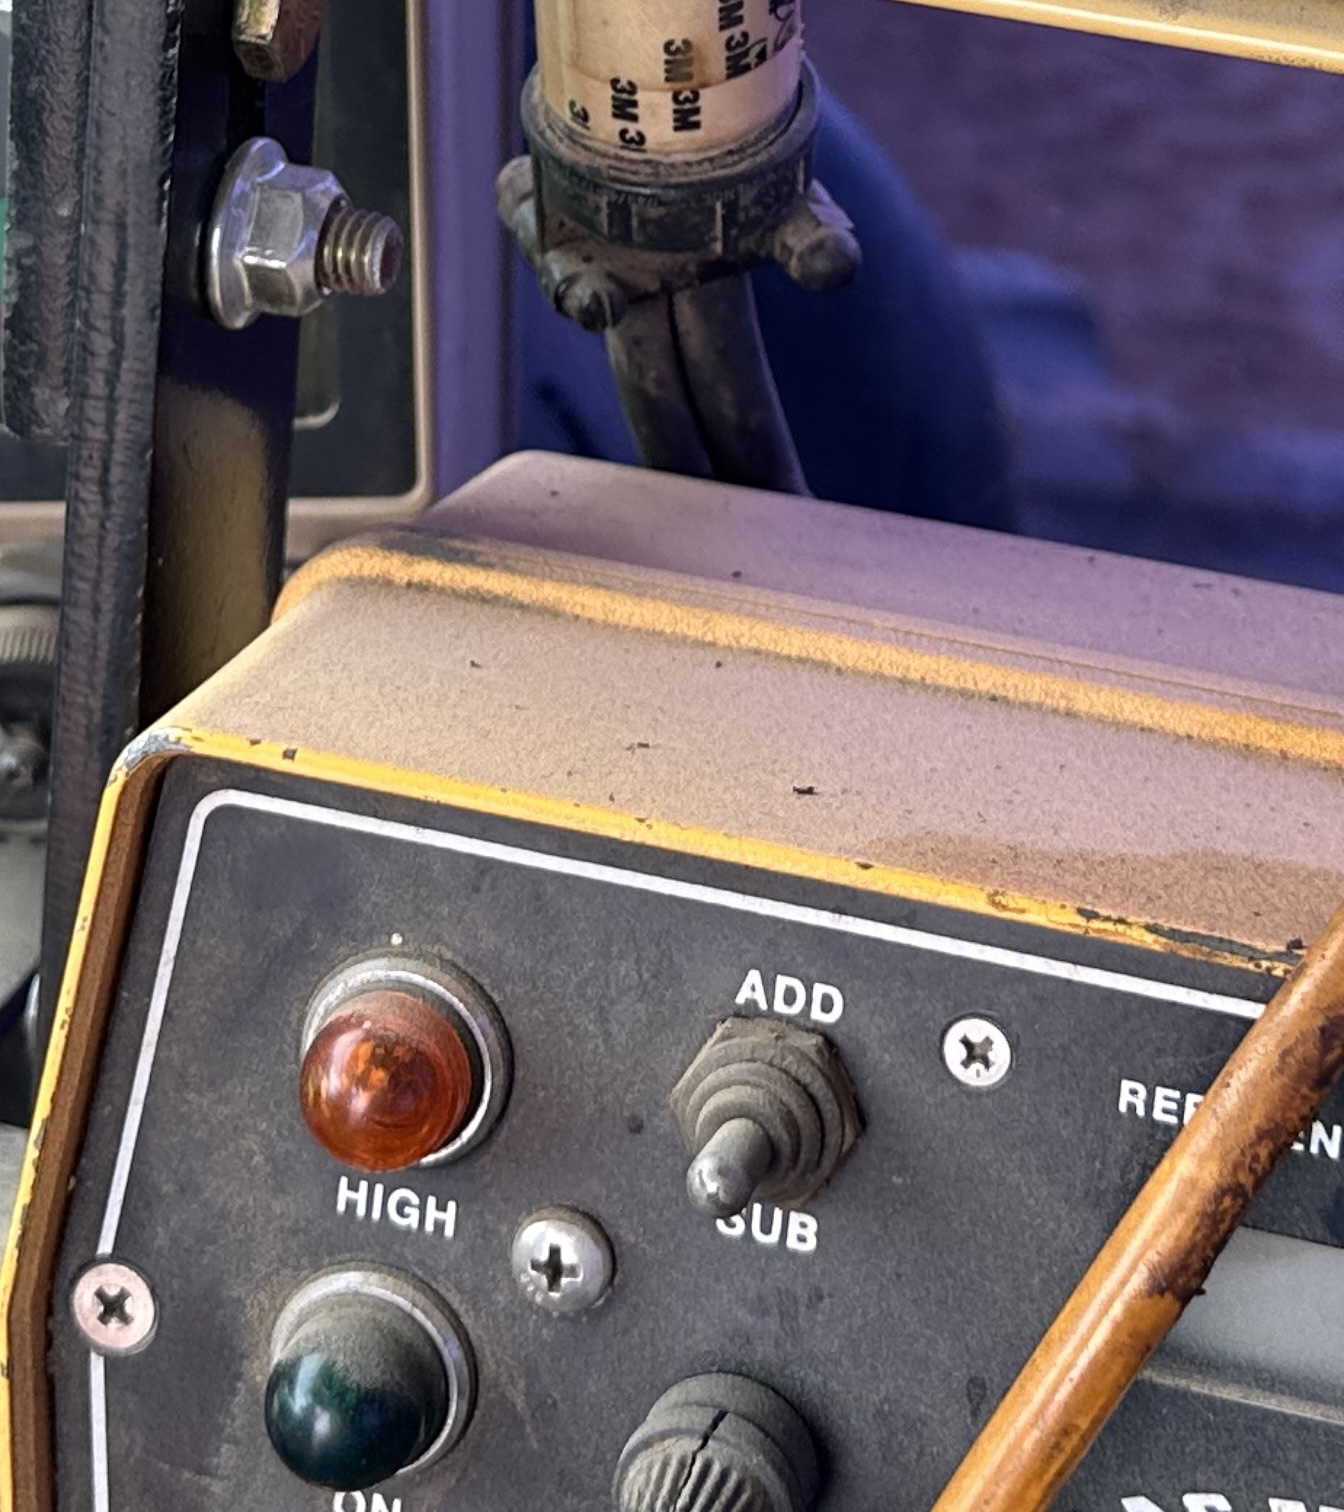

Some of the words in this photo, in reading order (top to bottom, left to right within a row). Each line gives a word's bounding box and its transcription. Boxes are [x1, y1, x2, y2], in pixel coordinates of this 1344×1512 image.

[663, 38, 695, 83] 3M
[724, 30, 752, 81] 3M
[609, 76, 640, 124] 3M
[672, 89, 702, 132] 3M
[619, 127, 648, 153] 3
[734, 968, 846, 1024] ADD
[336, 1175, 457, 1238] HIGH
